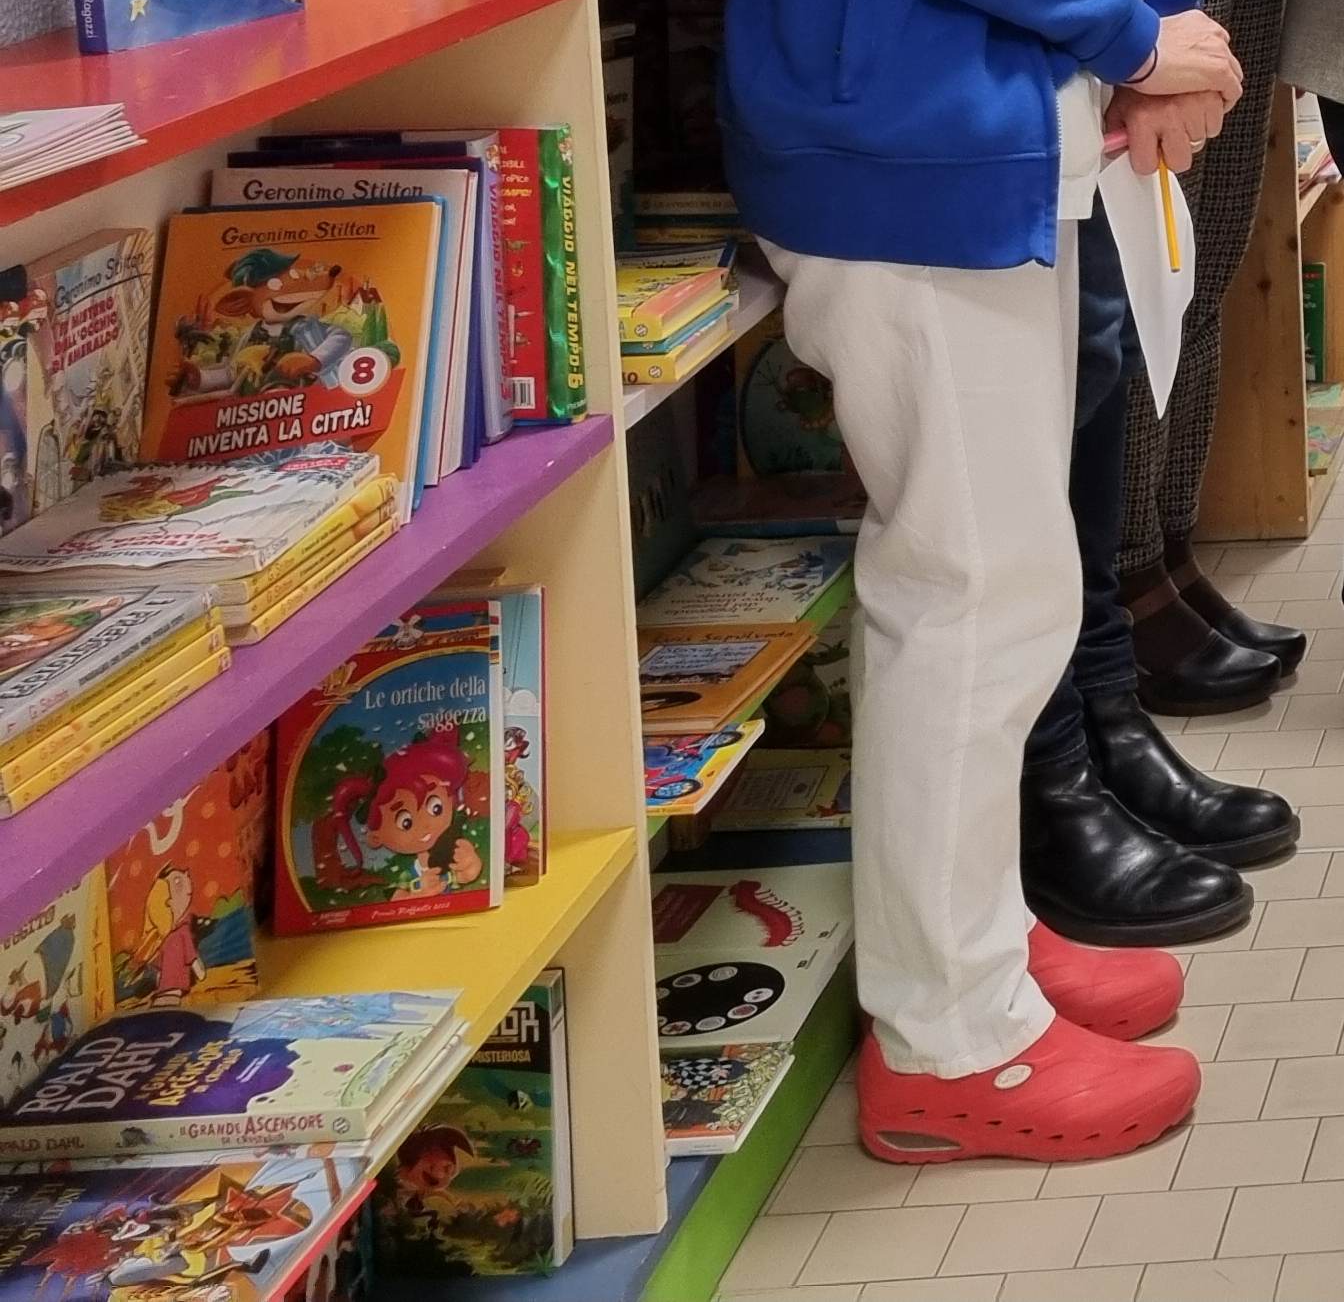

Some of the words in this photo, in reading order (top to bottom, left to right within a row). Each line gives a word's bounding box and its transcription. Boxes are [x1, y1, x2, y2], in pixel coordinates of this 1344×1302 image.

[243, 179, 345, 201] Geronimo
[352, 178, 424, 198] Stilton
[560, 175, 576, 252] VIAGGIO
[221, 226, 308, 247] Geronimo
[314, 220, 376, 240] Stilton
[564, 261, 578, 296] NEL
[352, 355, 376, 385] 8
[215, 392, 304, 429] MISSIONE
[187, 425, 270, 459] INVENTA
[278, 418, 302, 441] LA
[311, 399, 373, 436] CITTÀ!
[365, 689, 385, 710] Le
[390, 680, 444, 707] ortiche
[450, 674, 486, 704] della
[418, 705, 487, 733] saggezza
[14, 1037, 126, 1116] ROALD
[63, 1031, 185, 1112] DAHL
[46, 1136, 85, 1150] DAHL
[188, 1122, 242, 1139] GRANDE
[244, 1113, 324, 1134] ASCENSORE
